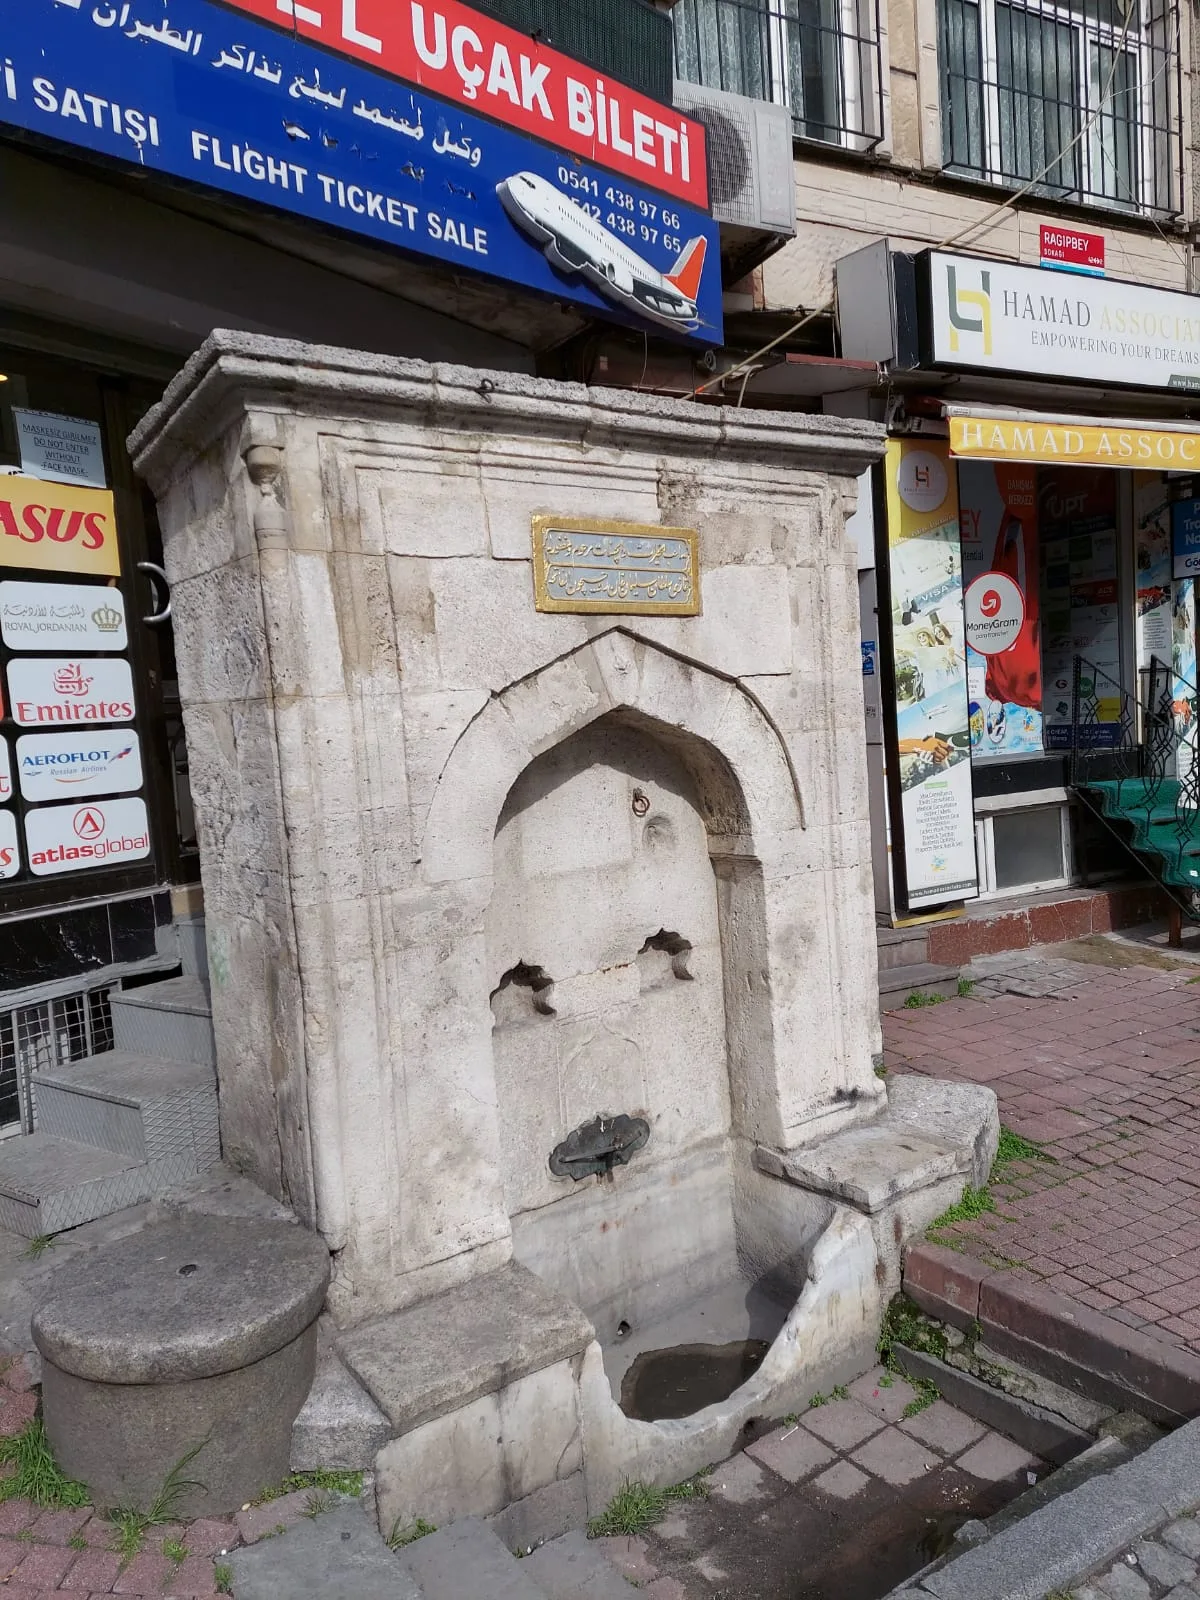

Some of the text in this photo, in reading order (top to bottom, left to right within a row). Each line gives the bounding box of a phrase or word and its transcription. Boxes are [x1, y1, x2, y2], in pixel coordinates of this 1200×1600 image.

[410, 1, 554, 121] UÇAK
[567, 77, 690, 183] BİLETİ
[0, 58, 489, 255] İ SATIŞI FLIGHT TICKET SALE
[558, 166, 681, 230] 0541 438 97 66
[606, 212, 636, 237] 438
[640, 225, 658, 245] 97
[663, 234, 681, 253] 65
[1044, 231, 1089, 252] RAGIPBEY
[1003, 290, 1091, 327] HAMAD
[1031, 331, 1199, 365] EMPOWERING YOUR DREAMS
[34, 437, 89, 455] DO NOT ENTER
[962, 422, 1196, 460] HAMAD ASSOC
[44, 451, 81, 463] WITHOUT
[921, 584, 949, 602] VISA
[4, 621, 87, 633] ROYAL JORDANIAN
[967, 617, 1018, 632] MoneyGram
[16, 700, 133, 722] Emirates
[22, 750, 111, 767] AEROFLOT
[50, 768, 78, 776] Russian
[31, 831, 149, 866] atlasglobal
